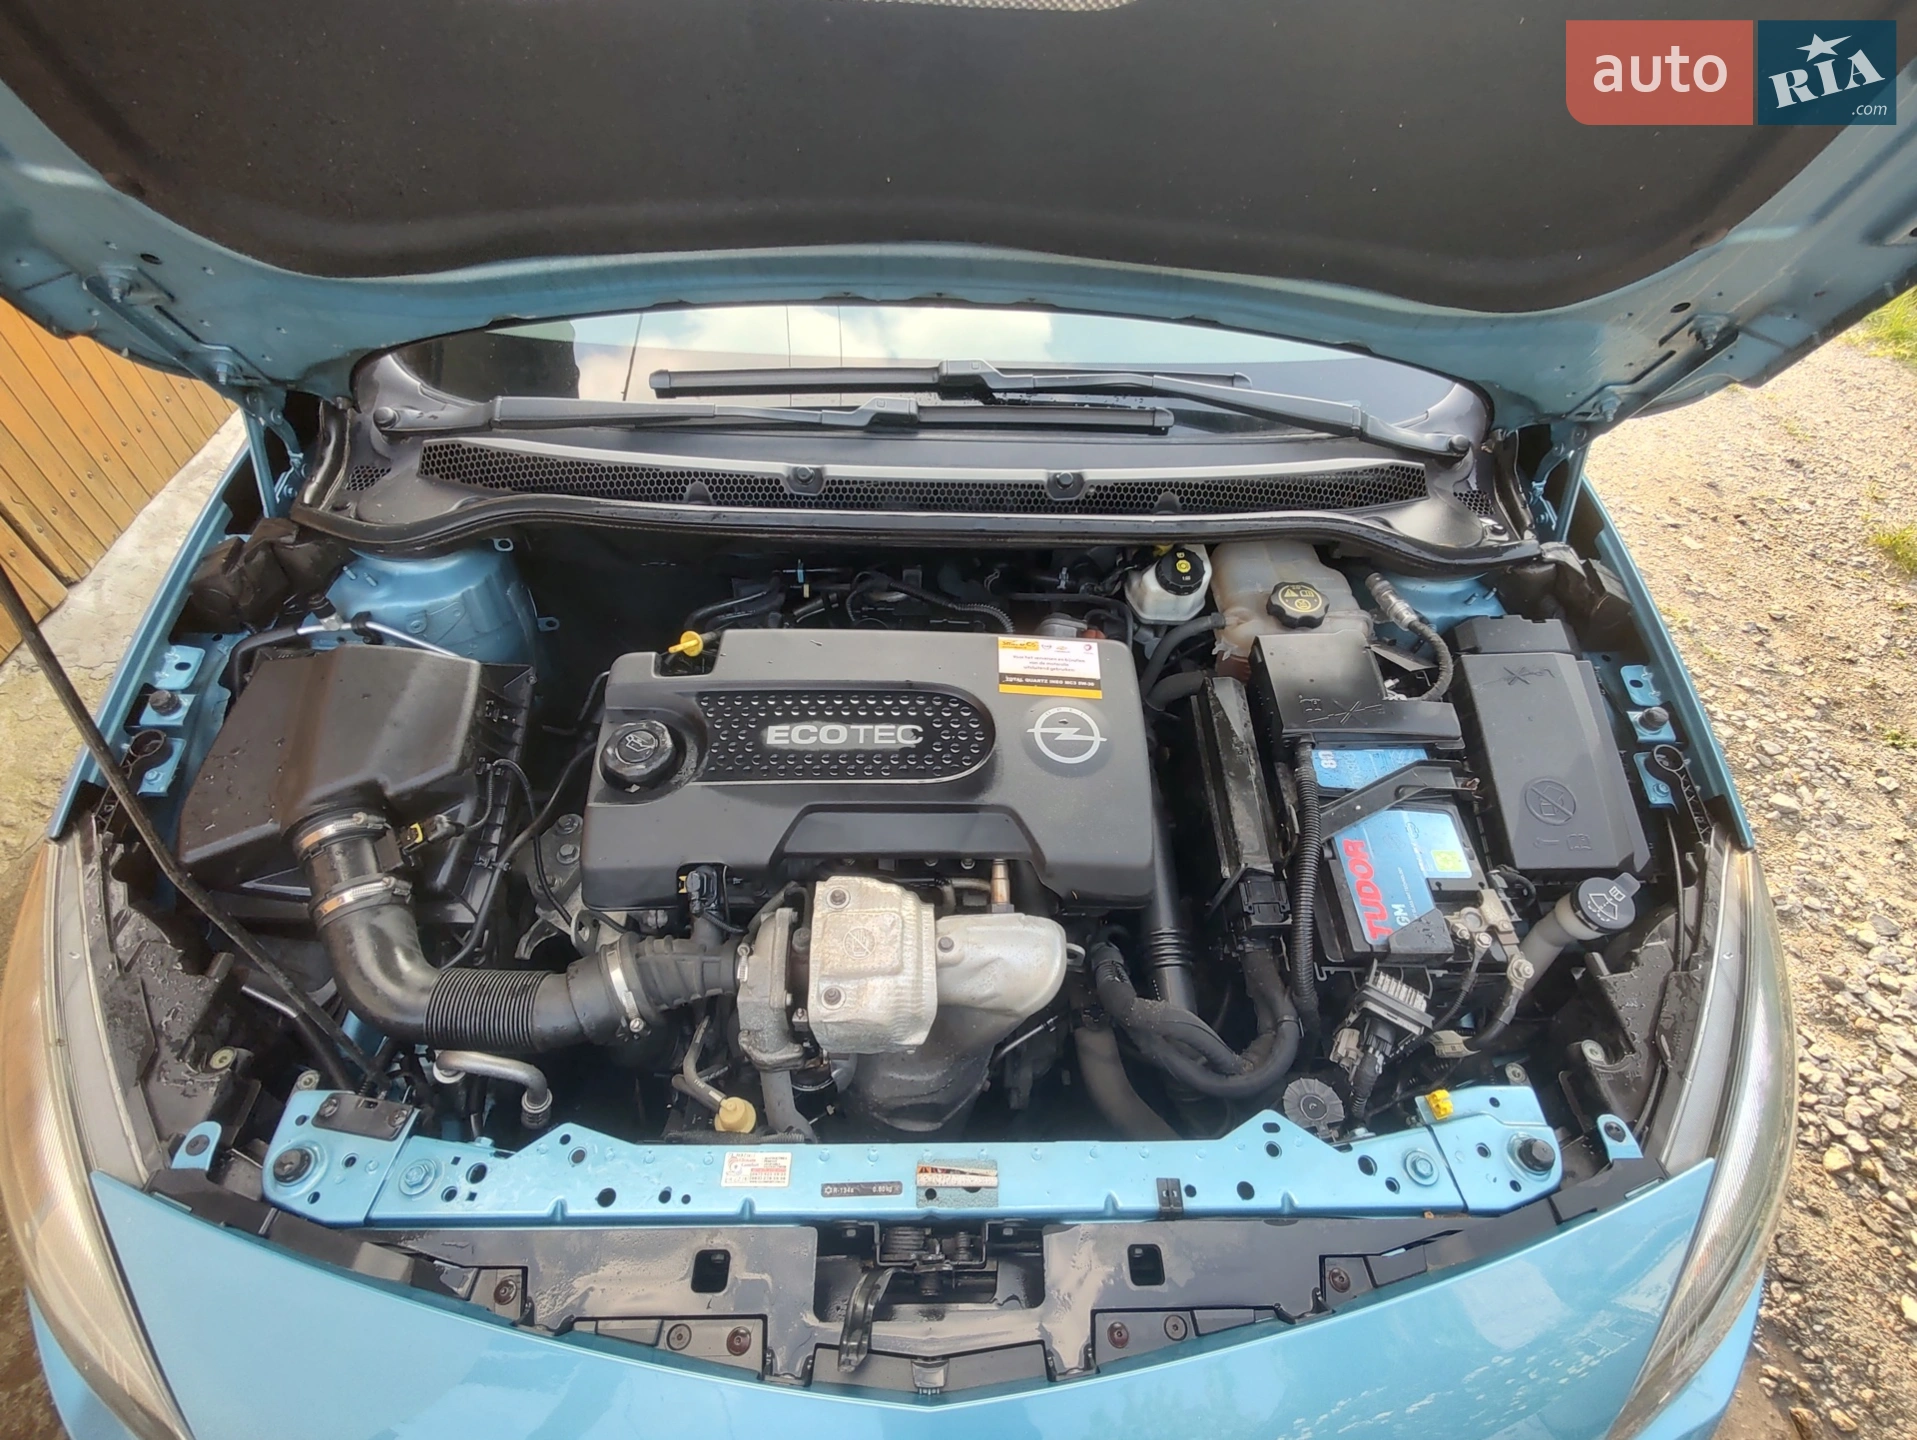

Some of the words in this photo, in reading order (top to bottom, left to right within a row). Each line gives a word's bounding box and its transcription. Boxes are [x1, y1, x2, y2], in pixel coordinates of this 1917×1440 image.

[766, 724, 924, 745] ECOTEC
[1342, 839, 1394, 940] TUDOR
[1393, 904, 1410, 926] GM
